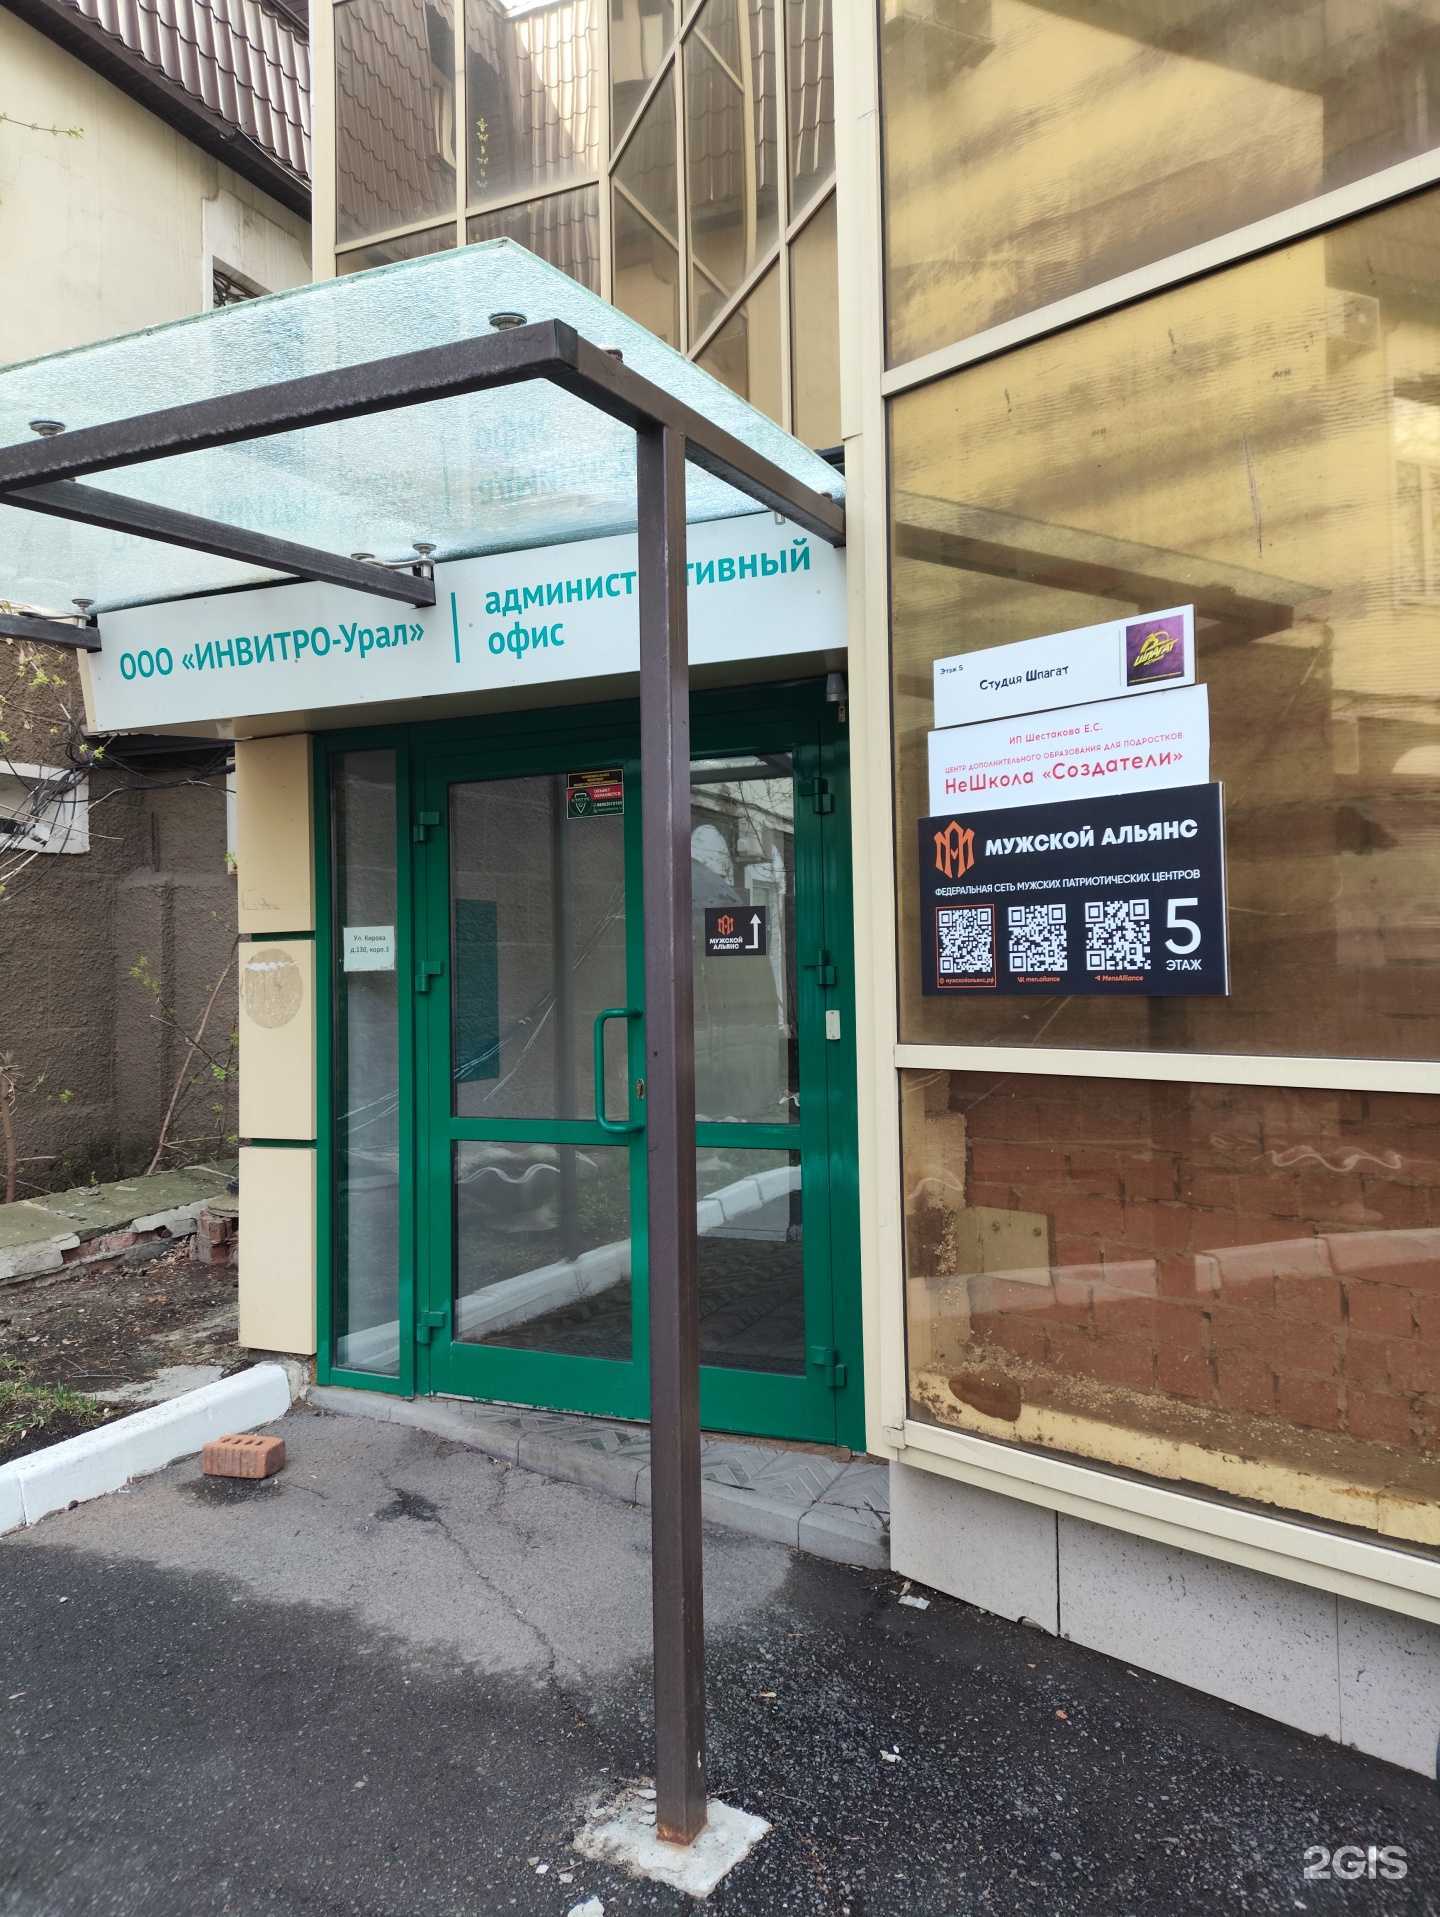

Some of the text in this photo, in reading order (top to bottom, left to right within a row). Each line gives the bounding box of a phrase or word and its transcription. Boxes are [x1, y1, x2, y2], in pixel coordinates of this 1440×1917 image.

[119, 622, 425, 681] ООО «ИНВИТРО-Урал»
[488, 621, 566, 660] офис
[979, 665, 1069, 691] Студия Шпагат
[945, 731, 1183, 774] ЦЕНТР ДОПОЛНИТЕЛЬНОГО ОБРАЗОВАНИЯ ДЛЯ ПОДРОСТКОВ
[1009, 735, 1022, 745] ИП
[1084, 722, 1104, 733] Е.С.
[945, 751, 1183, 795] НеШкола «Создатели»
[985, 818, 1198, 857] МУЖСКОЙ АЛЬЯНС
[935, 868, 1201, 897] ФЕДЕРАЛЬНАЯ СЕТЬ МУЖСКИХ ПАТРИОТИЧЕСКИХ ЦЕНТРОВ
[709, 935, 743, 945] МУЖСКОЙ
[1164, 897, 1202, 955] 5
[1166, 959, 1203, 971] ЭТАЖ
